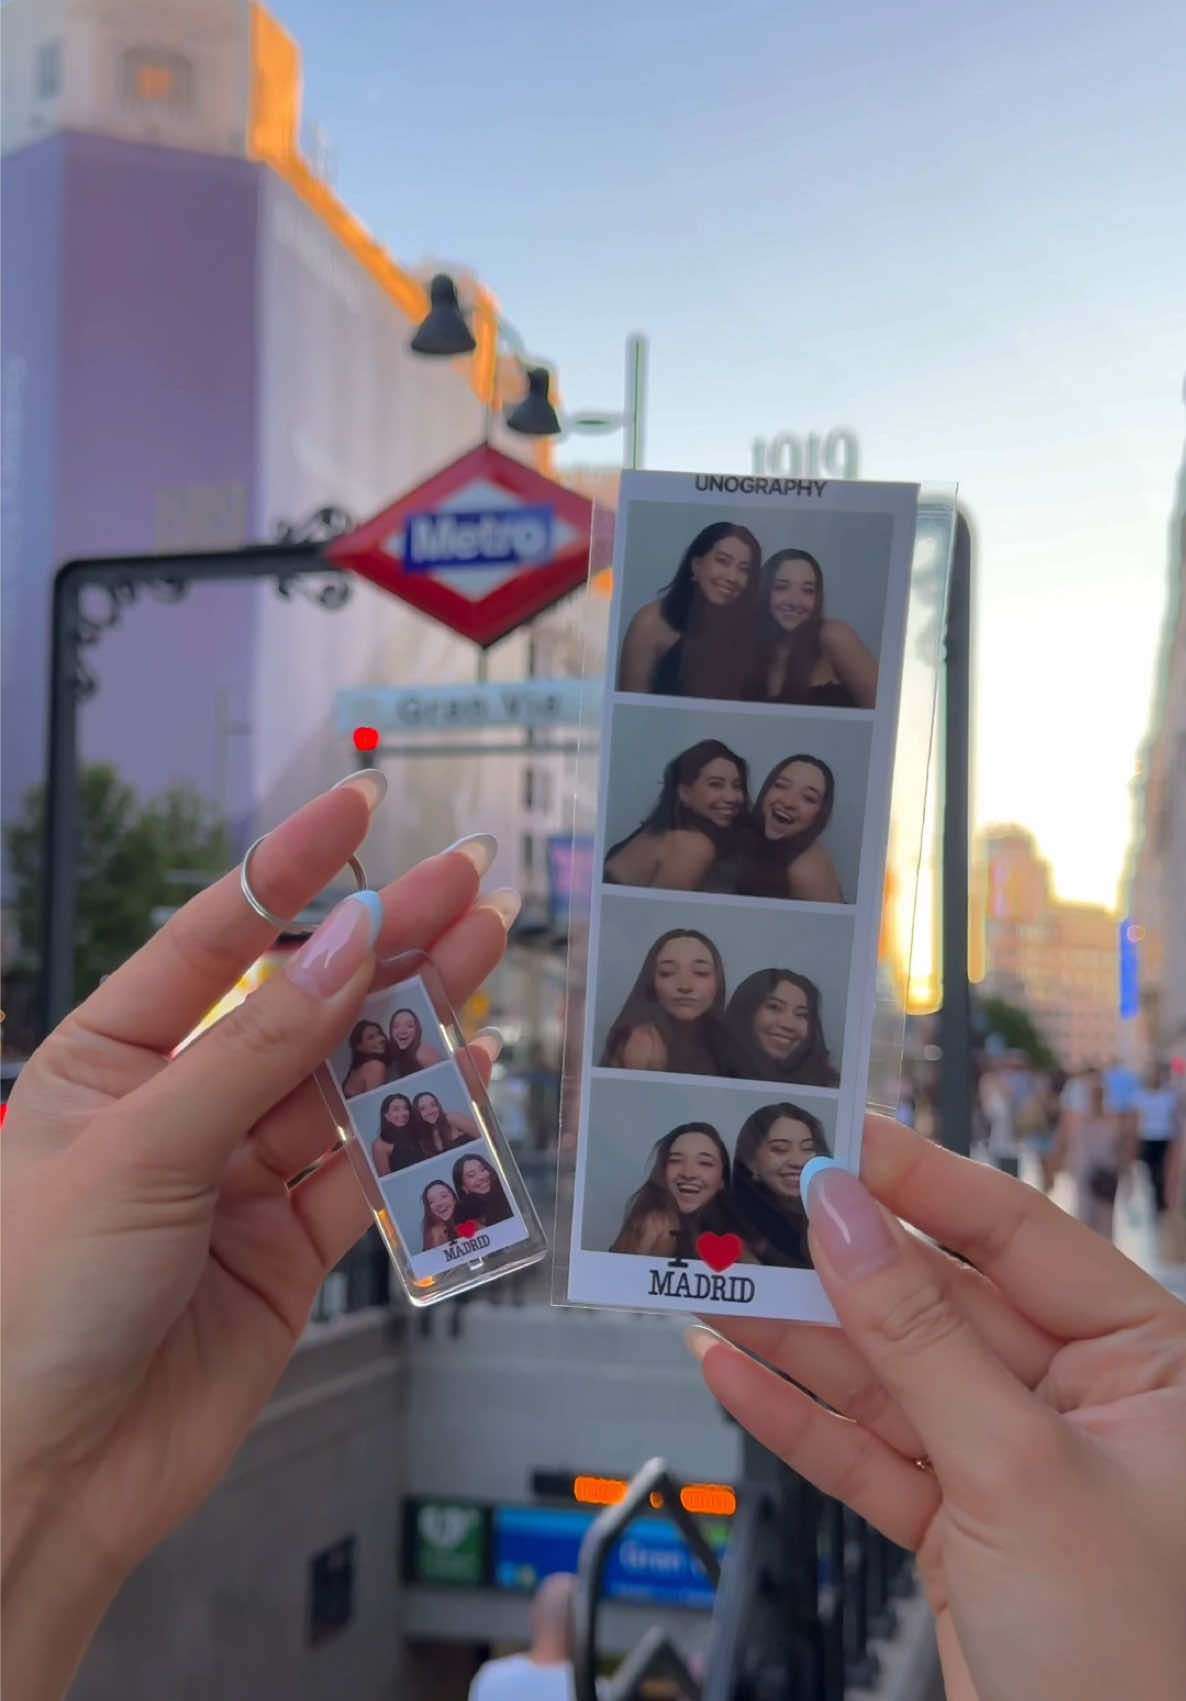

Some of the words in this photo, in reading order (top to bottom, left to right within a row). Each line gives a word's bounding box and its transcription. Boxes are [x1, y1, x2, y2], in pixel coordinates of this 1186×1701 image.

[694, 475, 828, 498] UNOGRAPHY
[410, 514, 548, 563] Metro
[443, 1234, 491, 1262] MADRID
[648, 1269, 756, 1303] MADRID
